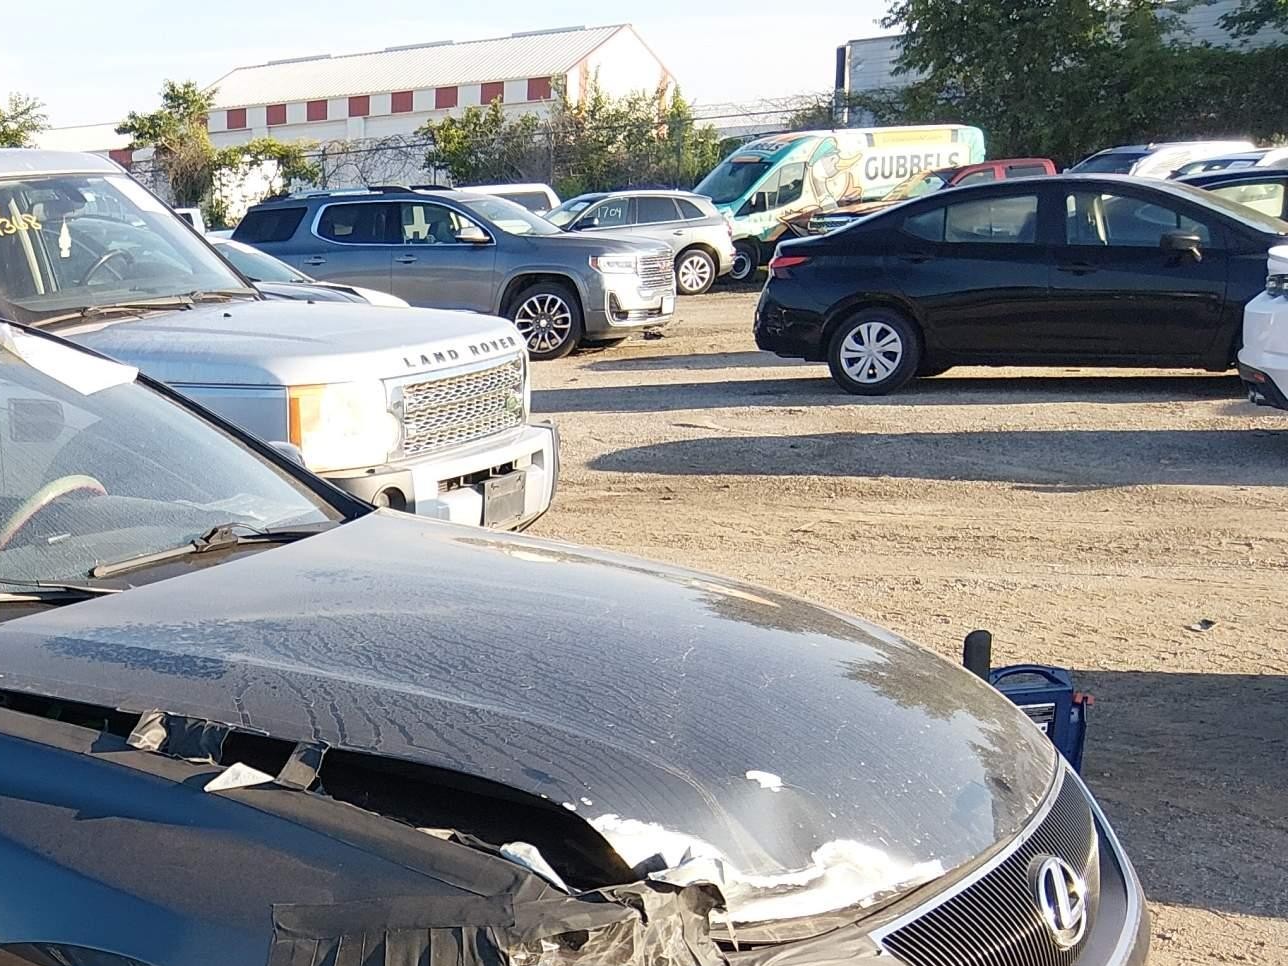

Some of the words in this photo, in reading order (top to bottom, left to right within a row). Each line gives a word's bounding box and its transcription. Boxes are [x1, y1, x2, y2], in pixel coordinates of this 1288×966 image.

[597, 206, 622, 219] 1704
[403, 349, 459, 368] LAND
[468, 336, 517, 356] ROVER
